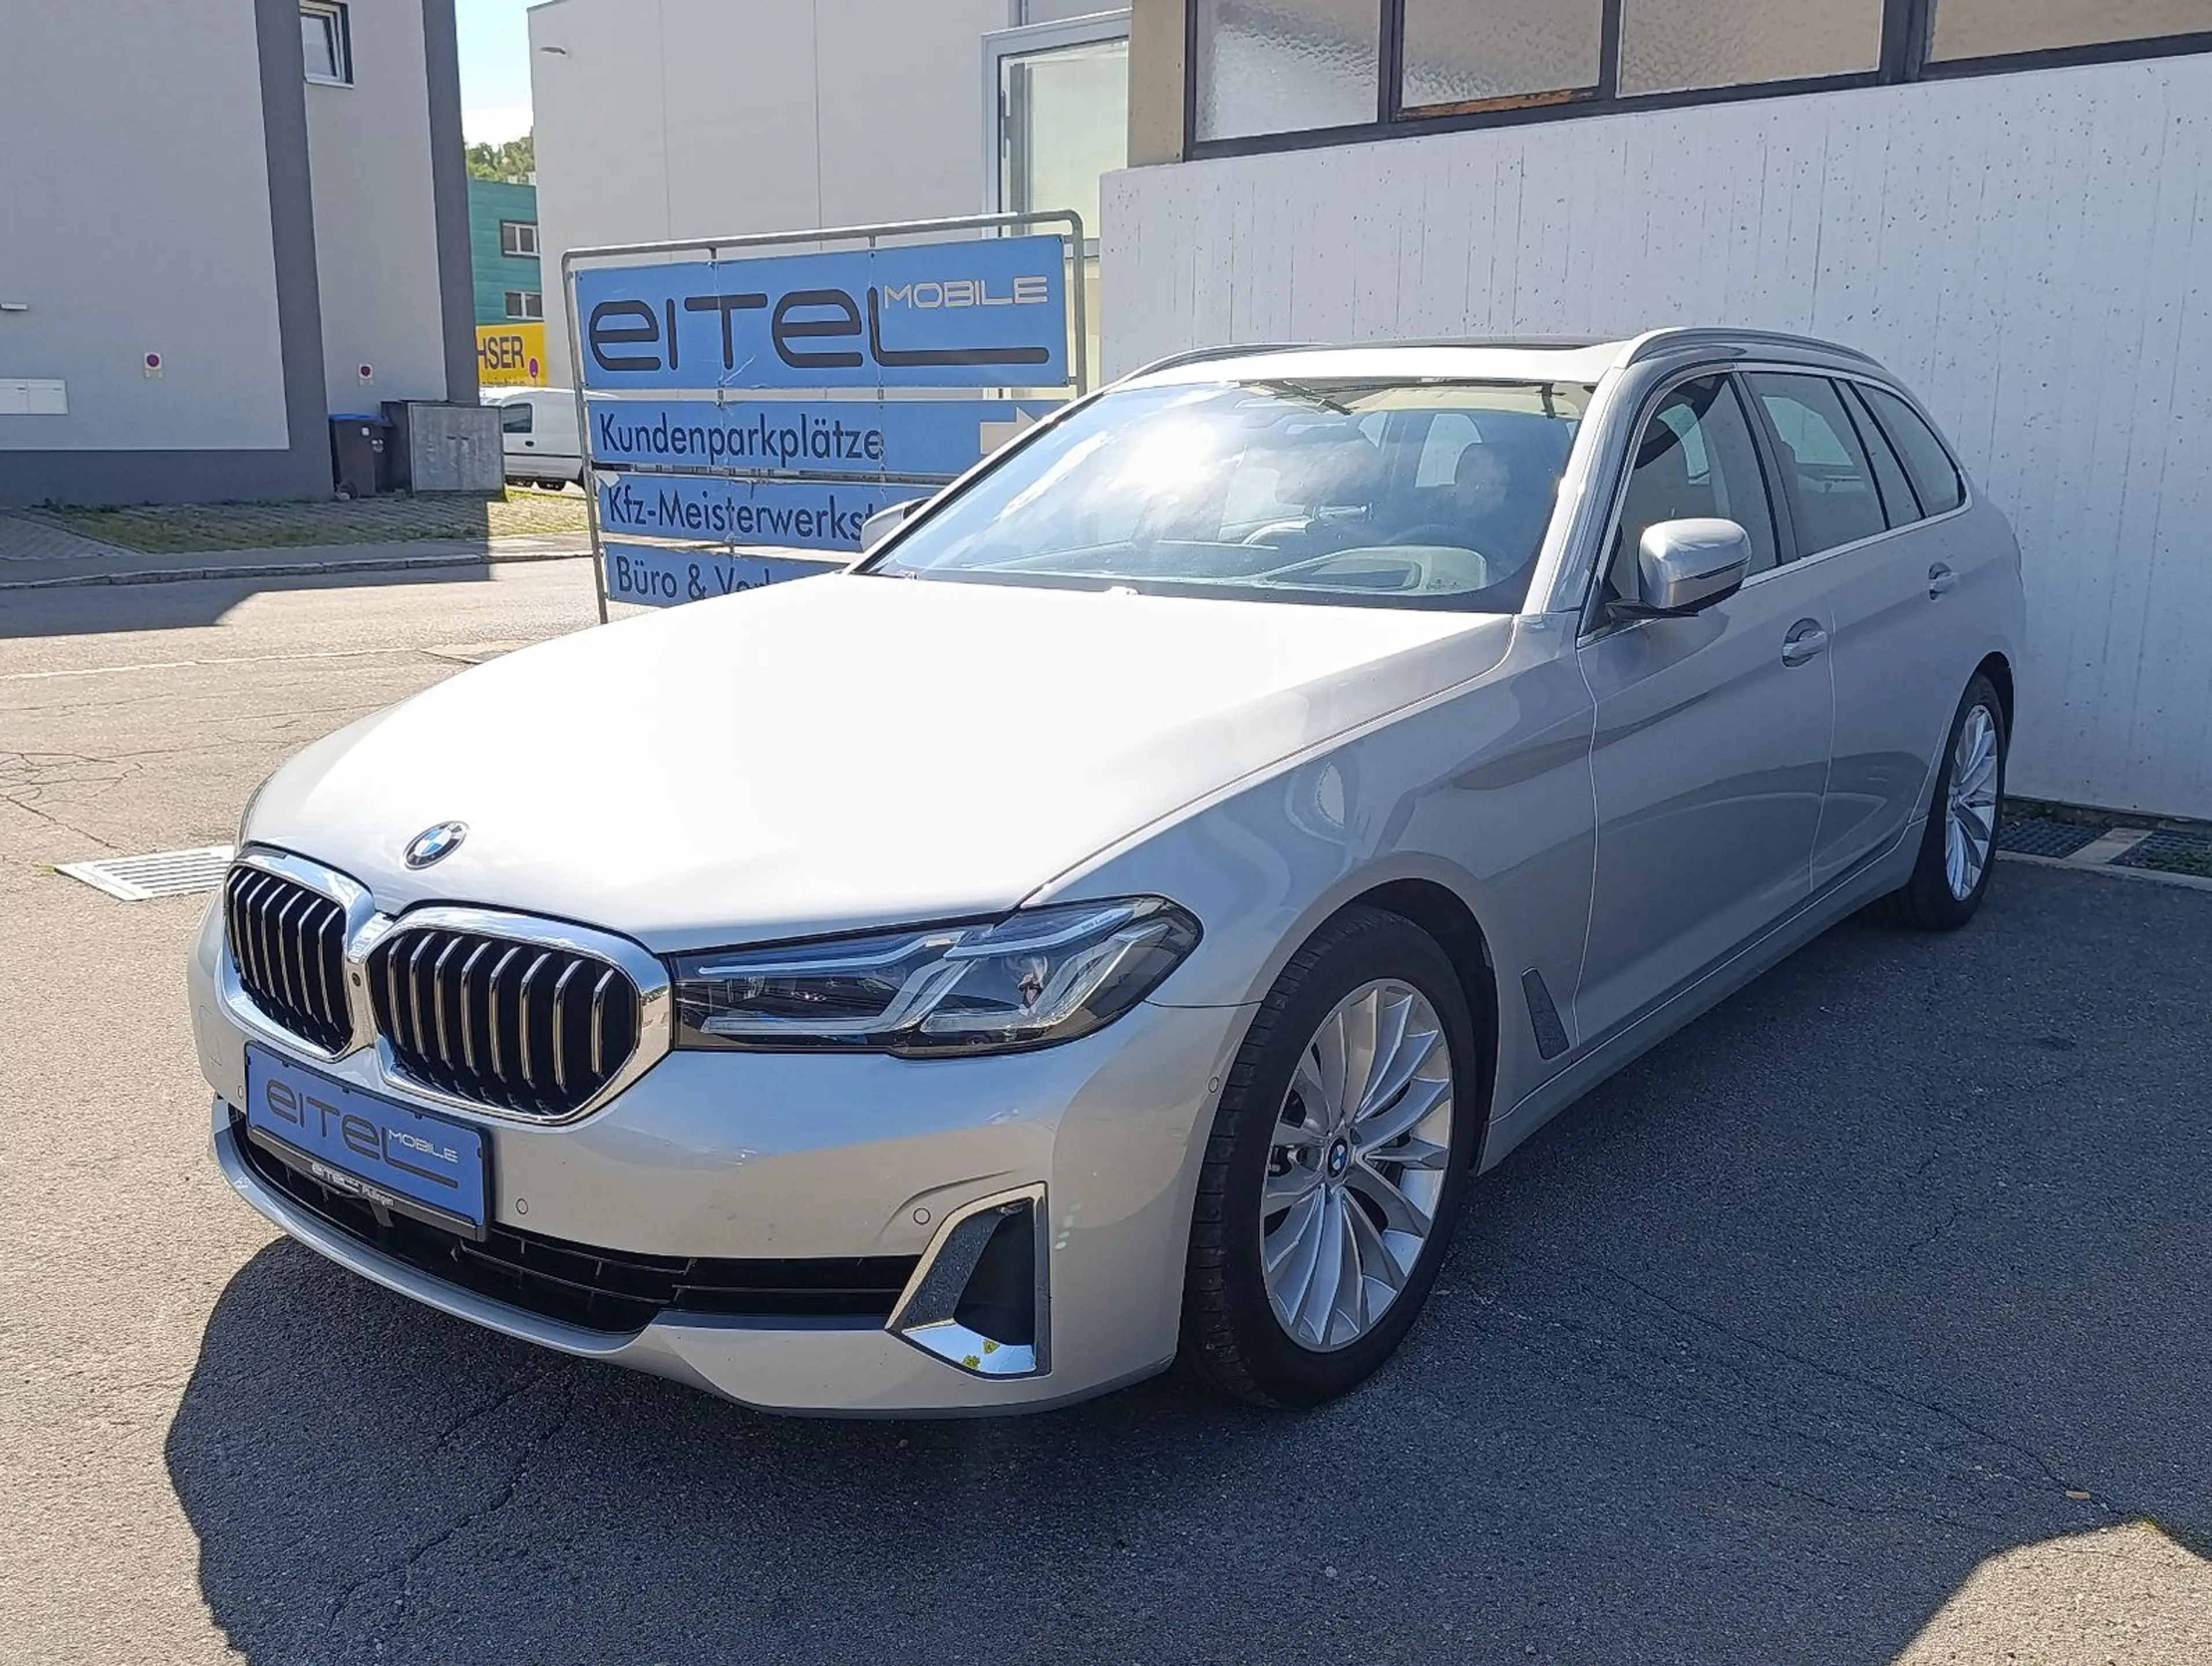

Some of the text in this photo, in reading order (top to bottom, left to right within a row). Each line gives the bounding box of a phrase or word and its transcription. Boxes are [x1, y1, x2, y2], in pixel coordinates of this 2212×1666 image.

[884, 276, 1048, 309] MOBILE
[599, 412, 884, 468] Kundenparkplätze
[616, 555, 677, 598] Büro
[688, 563, 707, 600] &
[388, 1129, 458, 1163] MOBILE
